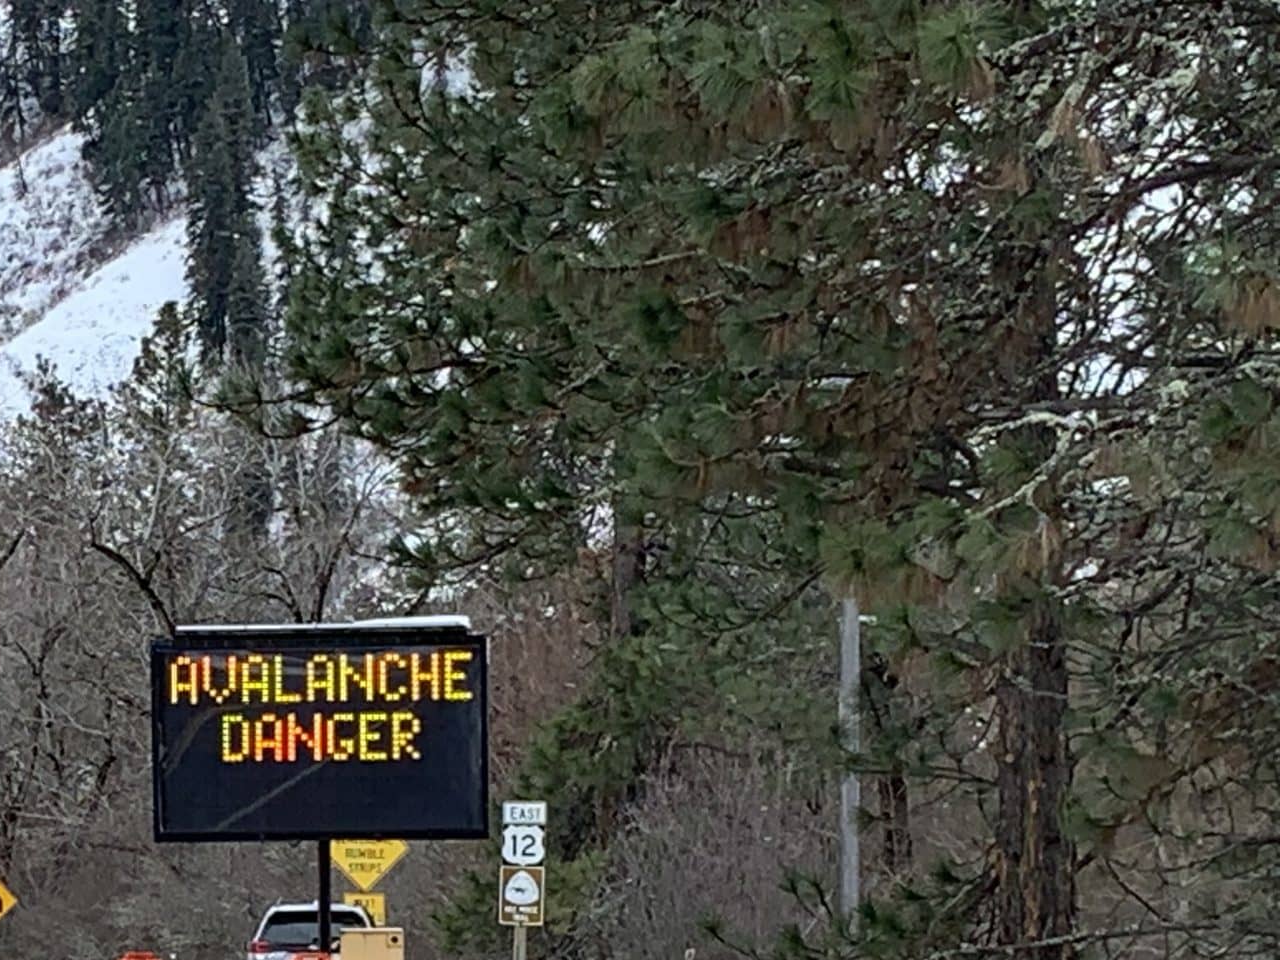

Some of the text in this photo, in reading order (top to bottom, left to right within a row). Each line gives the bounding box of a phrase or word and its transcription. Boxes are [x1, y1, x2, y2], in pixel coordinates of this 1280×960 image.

[170, 651, 473, 704] AVALANCHE
[222, 712, 421, 762] DANGER
[510, 806, 542, 820] EAST
[511, 834, 537, 857] 12
